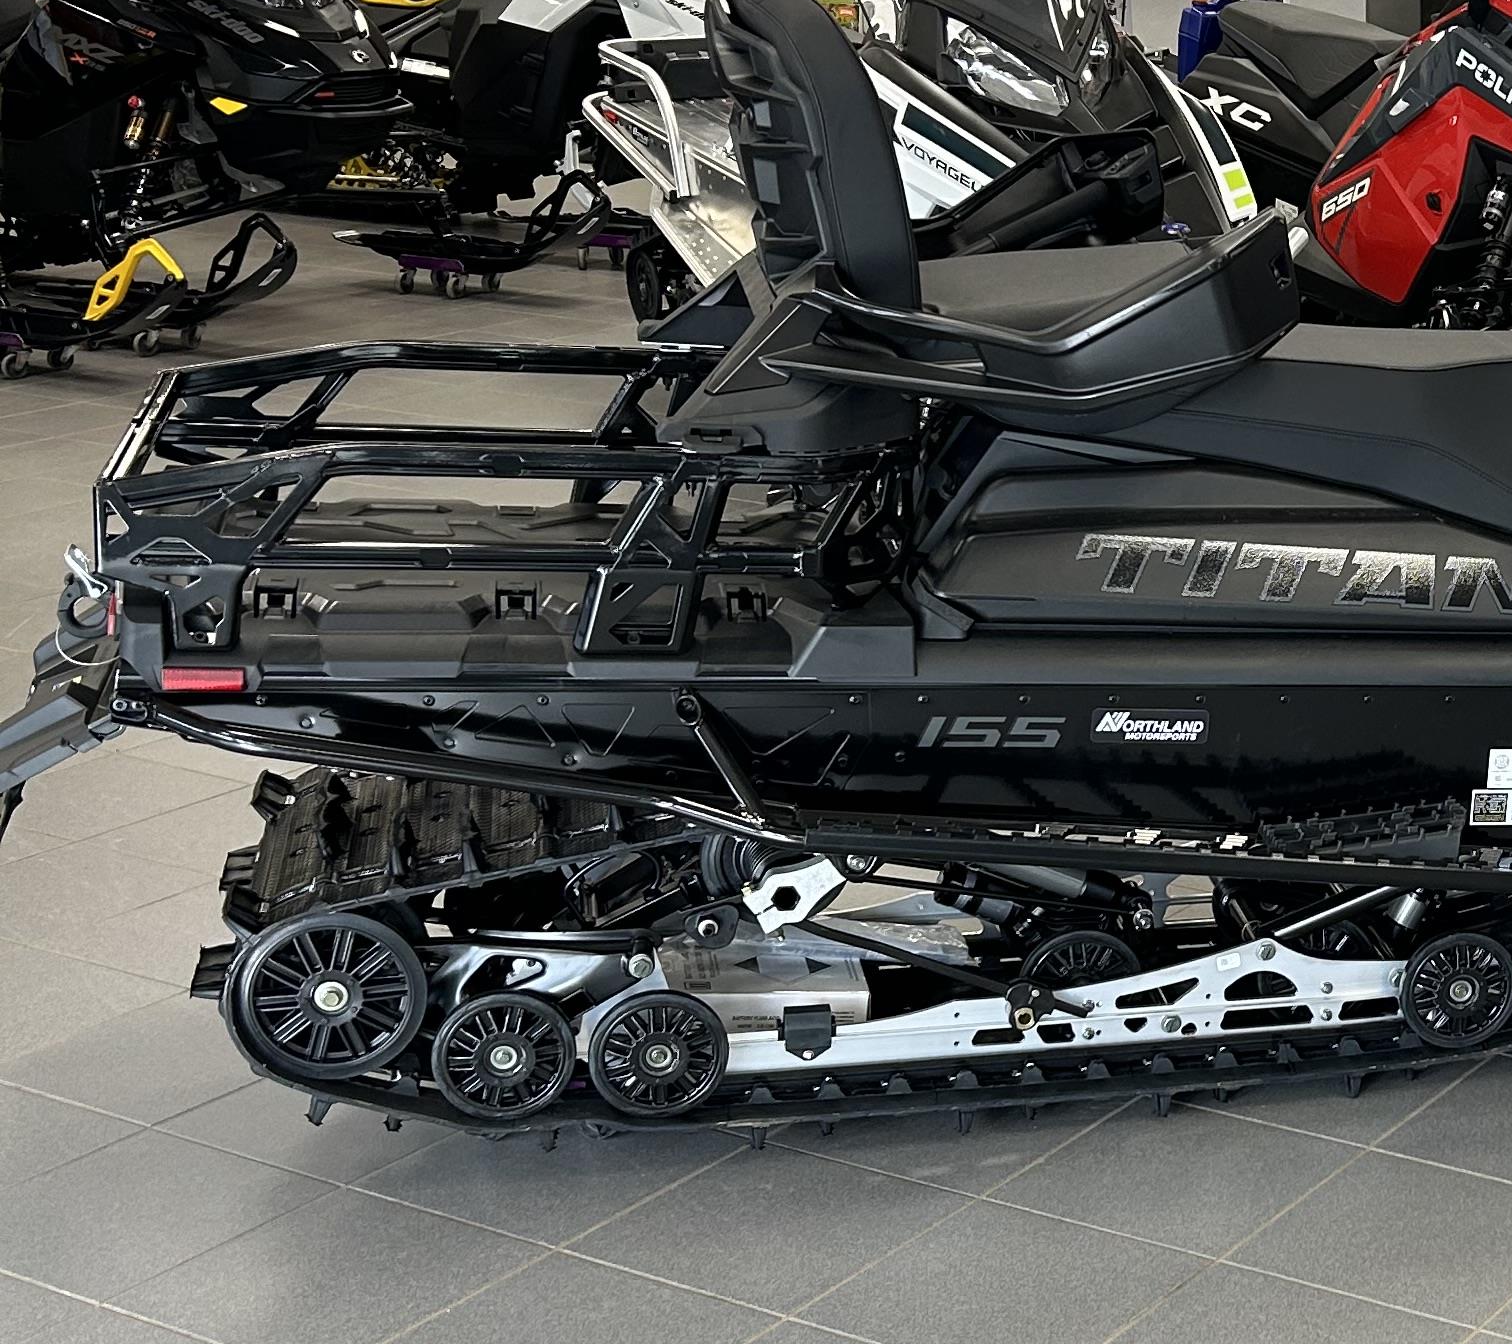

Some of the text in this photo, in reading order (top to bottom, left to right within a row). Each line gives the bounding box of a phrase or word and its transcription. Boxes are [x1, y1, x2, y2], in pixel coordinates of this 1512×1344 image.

[1201, 87, 1272, 131] XC
[1321, 177, 1371, 222] 650
[917, 715, 1067, 748] 155
[1095, 711, 1205, 733] NORTHLAND
[1124, 732, 1198, 741] MOTORSPORTS
